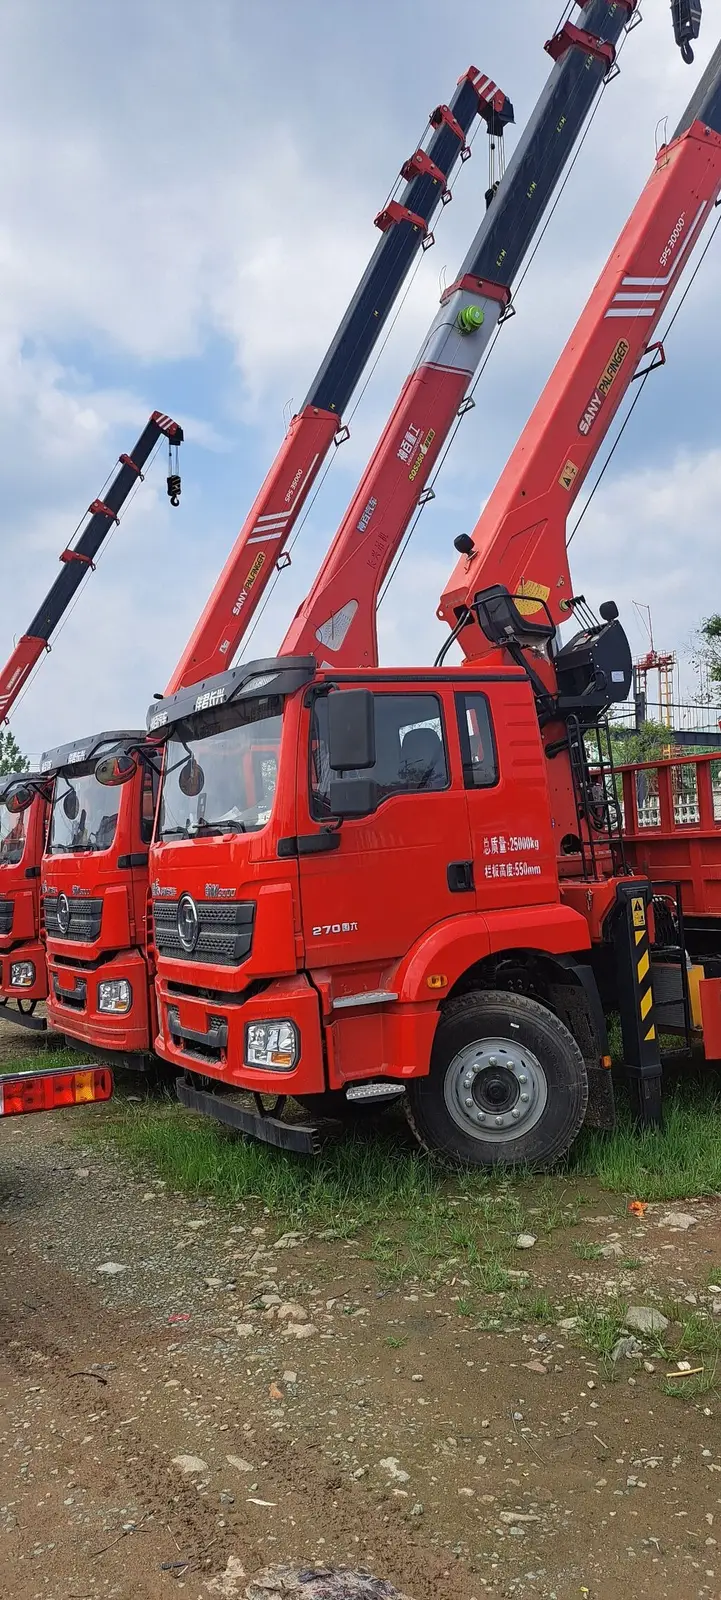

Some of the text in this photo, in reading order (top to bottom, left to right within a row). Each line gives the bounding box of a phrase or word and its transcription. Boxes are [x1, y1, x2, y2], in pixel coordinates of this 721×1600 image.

[660, 217, 685, 266] SPS 30000
[578, 340, 629, 435] SANY PALFINGER
[396, 422, 421, 463] 神百重工
[285, 468, 303, 503] SPS 35000
[232, 552, 266, 616] SANY PALFINGER
[194, 687, 226, 712] 伴君长兴
